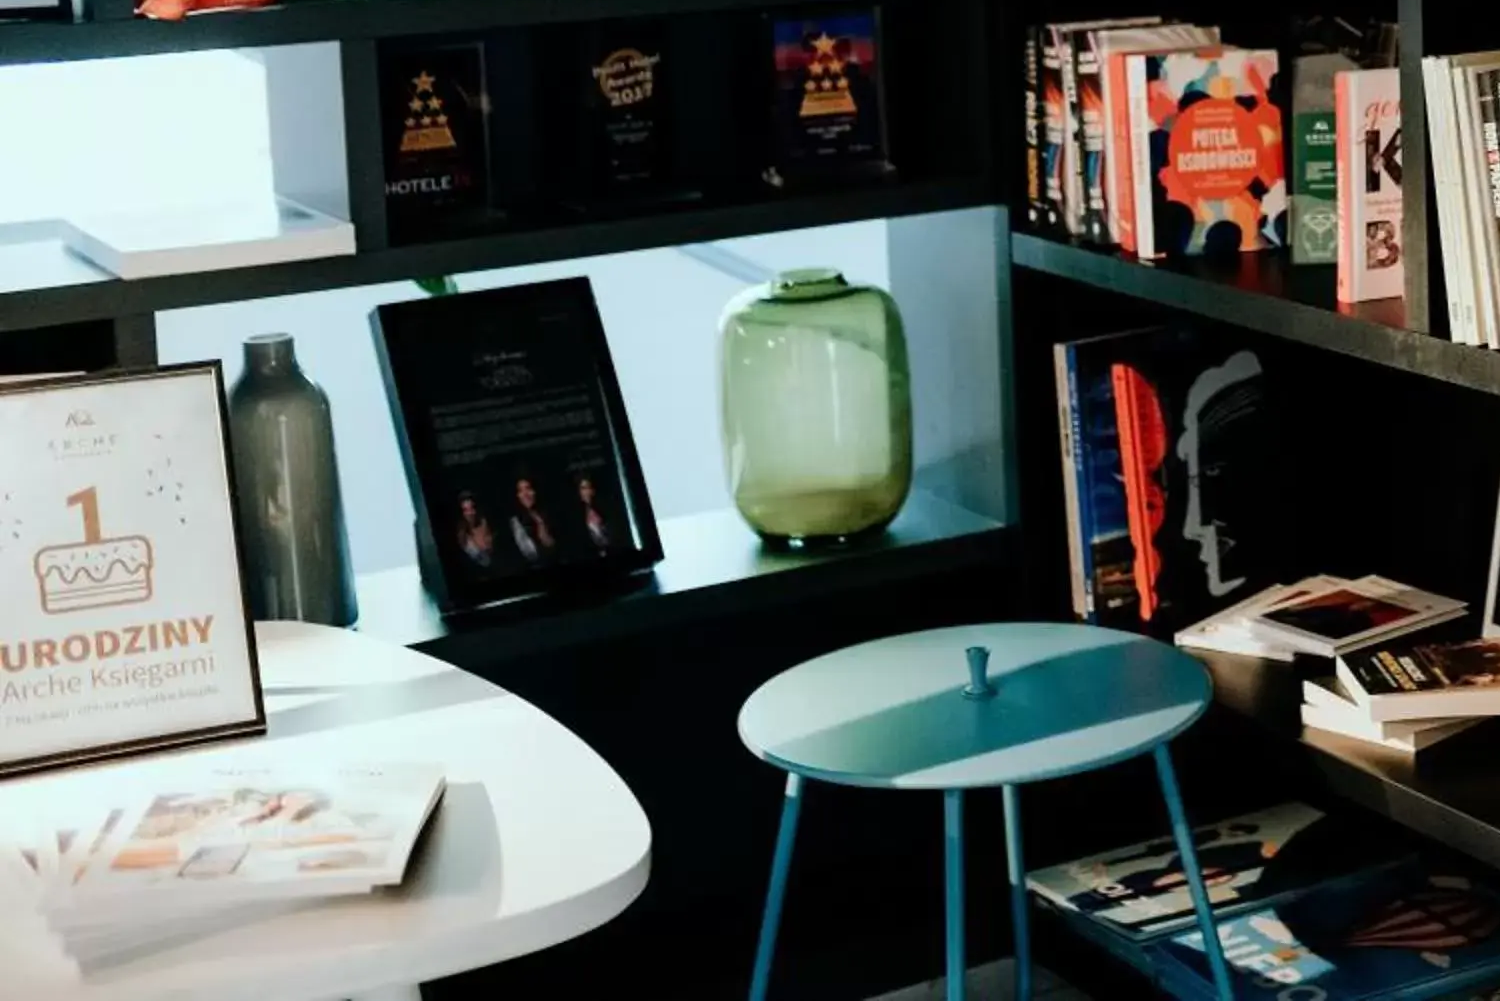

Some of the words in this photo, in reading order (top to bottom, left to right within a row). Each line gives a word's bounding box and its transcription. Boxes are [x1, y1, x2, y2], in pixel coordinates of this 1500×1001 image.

[609, 83, 654, 107] 2017
[385, 176, 453, 197] HOTELE
[65, 485, 102, 544] 1
[0, 614, 214, 674] URODZINY
[3, 673, 82, 705] Arche
[90, 650, 216, 689] Księgarni
